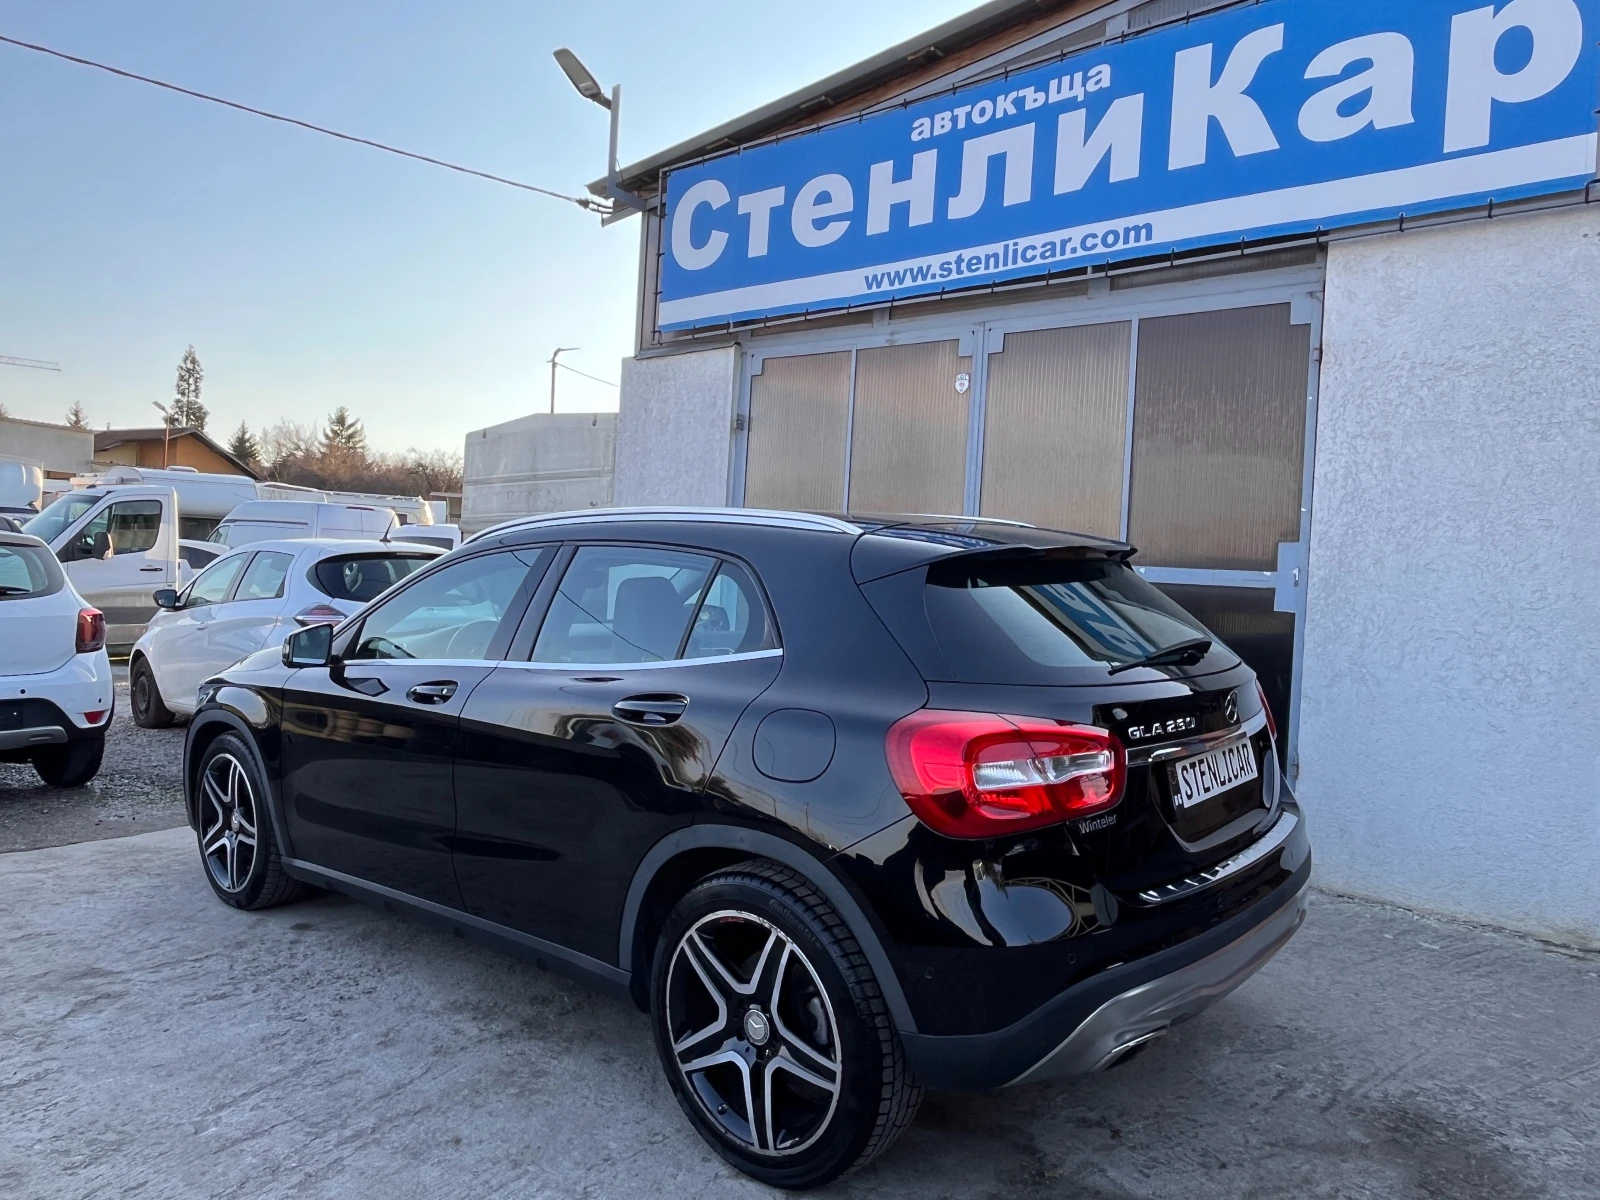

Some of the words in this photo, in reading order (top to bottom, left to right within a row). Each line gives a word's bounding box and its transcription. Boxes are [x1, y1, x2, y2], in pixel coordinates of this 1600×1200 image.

[911, 63, 1111, 142] автокъща
[864, 220, 1153, 290] www.stenlicar.com
[1128, 723, 1164, 740] GLA
[1181, 742, 1254, 801] STENLICAR
[1079, 814, 1117, 834] Winteler
